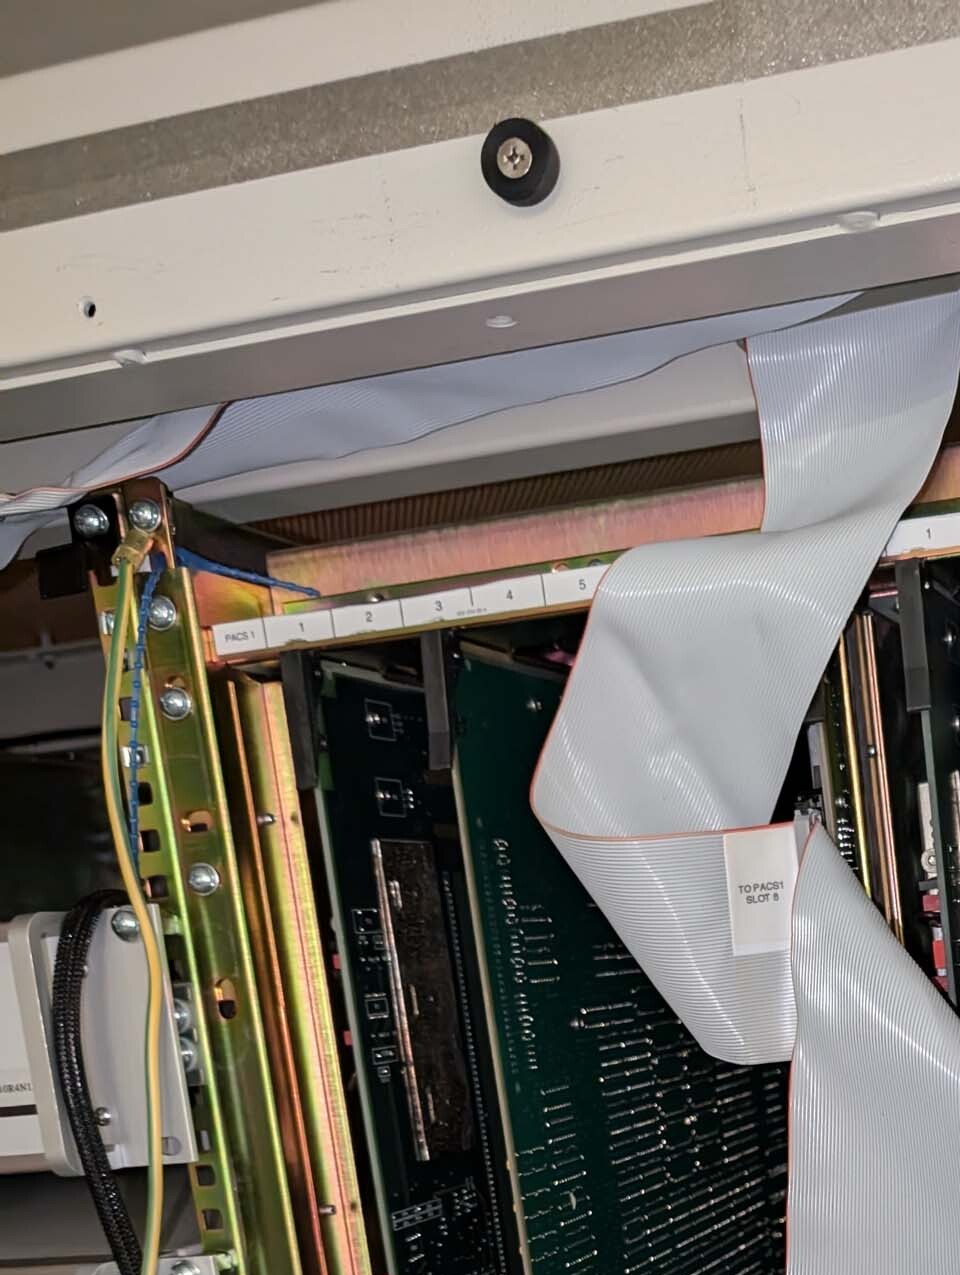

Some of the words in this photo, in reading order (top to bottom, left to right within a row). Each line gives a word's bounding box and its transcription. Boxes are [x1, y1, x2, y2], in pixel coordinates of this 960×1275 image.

[225, 632, 249, 643] PACS
[366, 611, 373, 622] 2
[435, 600, 443, 611] 3
[506, 589, 514, 600] 4
[579, 579, 586, 590] 5
[738, 885, 751, 894] TO
[753, 881, 784, 892] PACS1
[746, 894, 770, 904] SLOT
